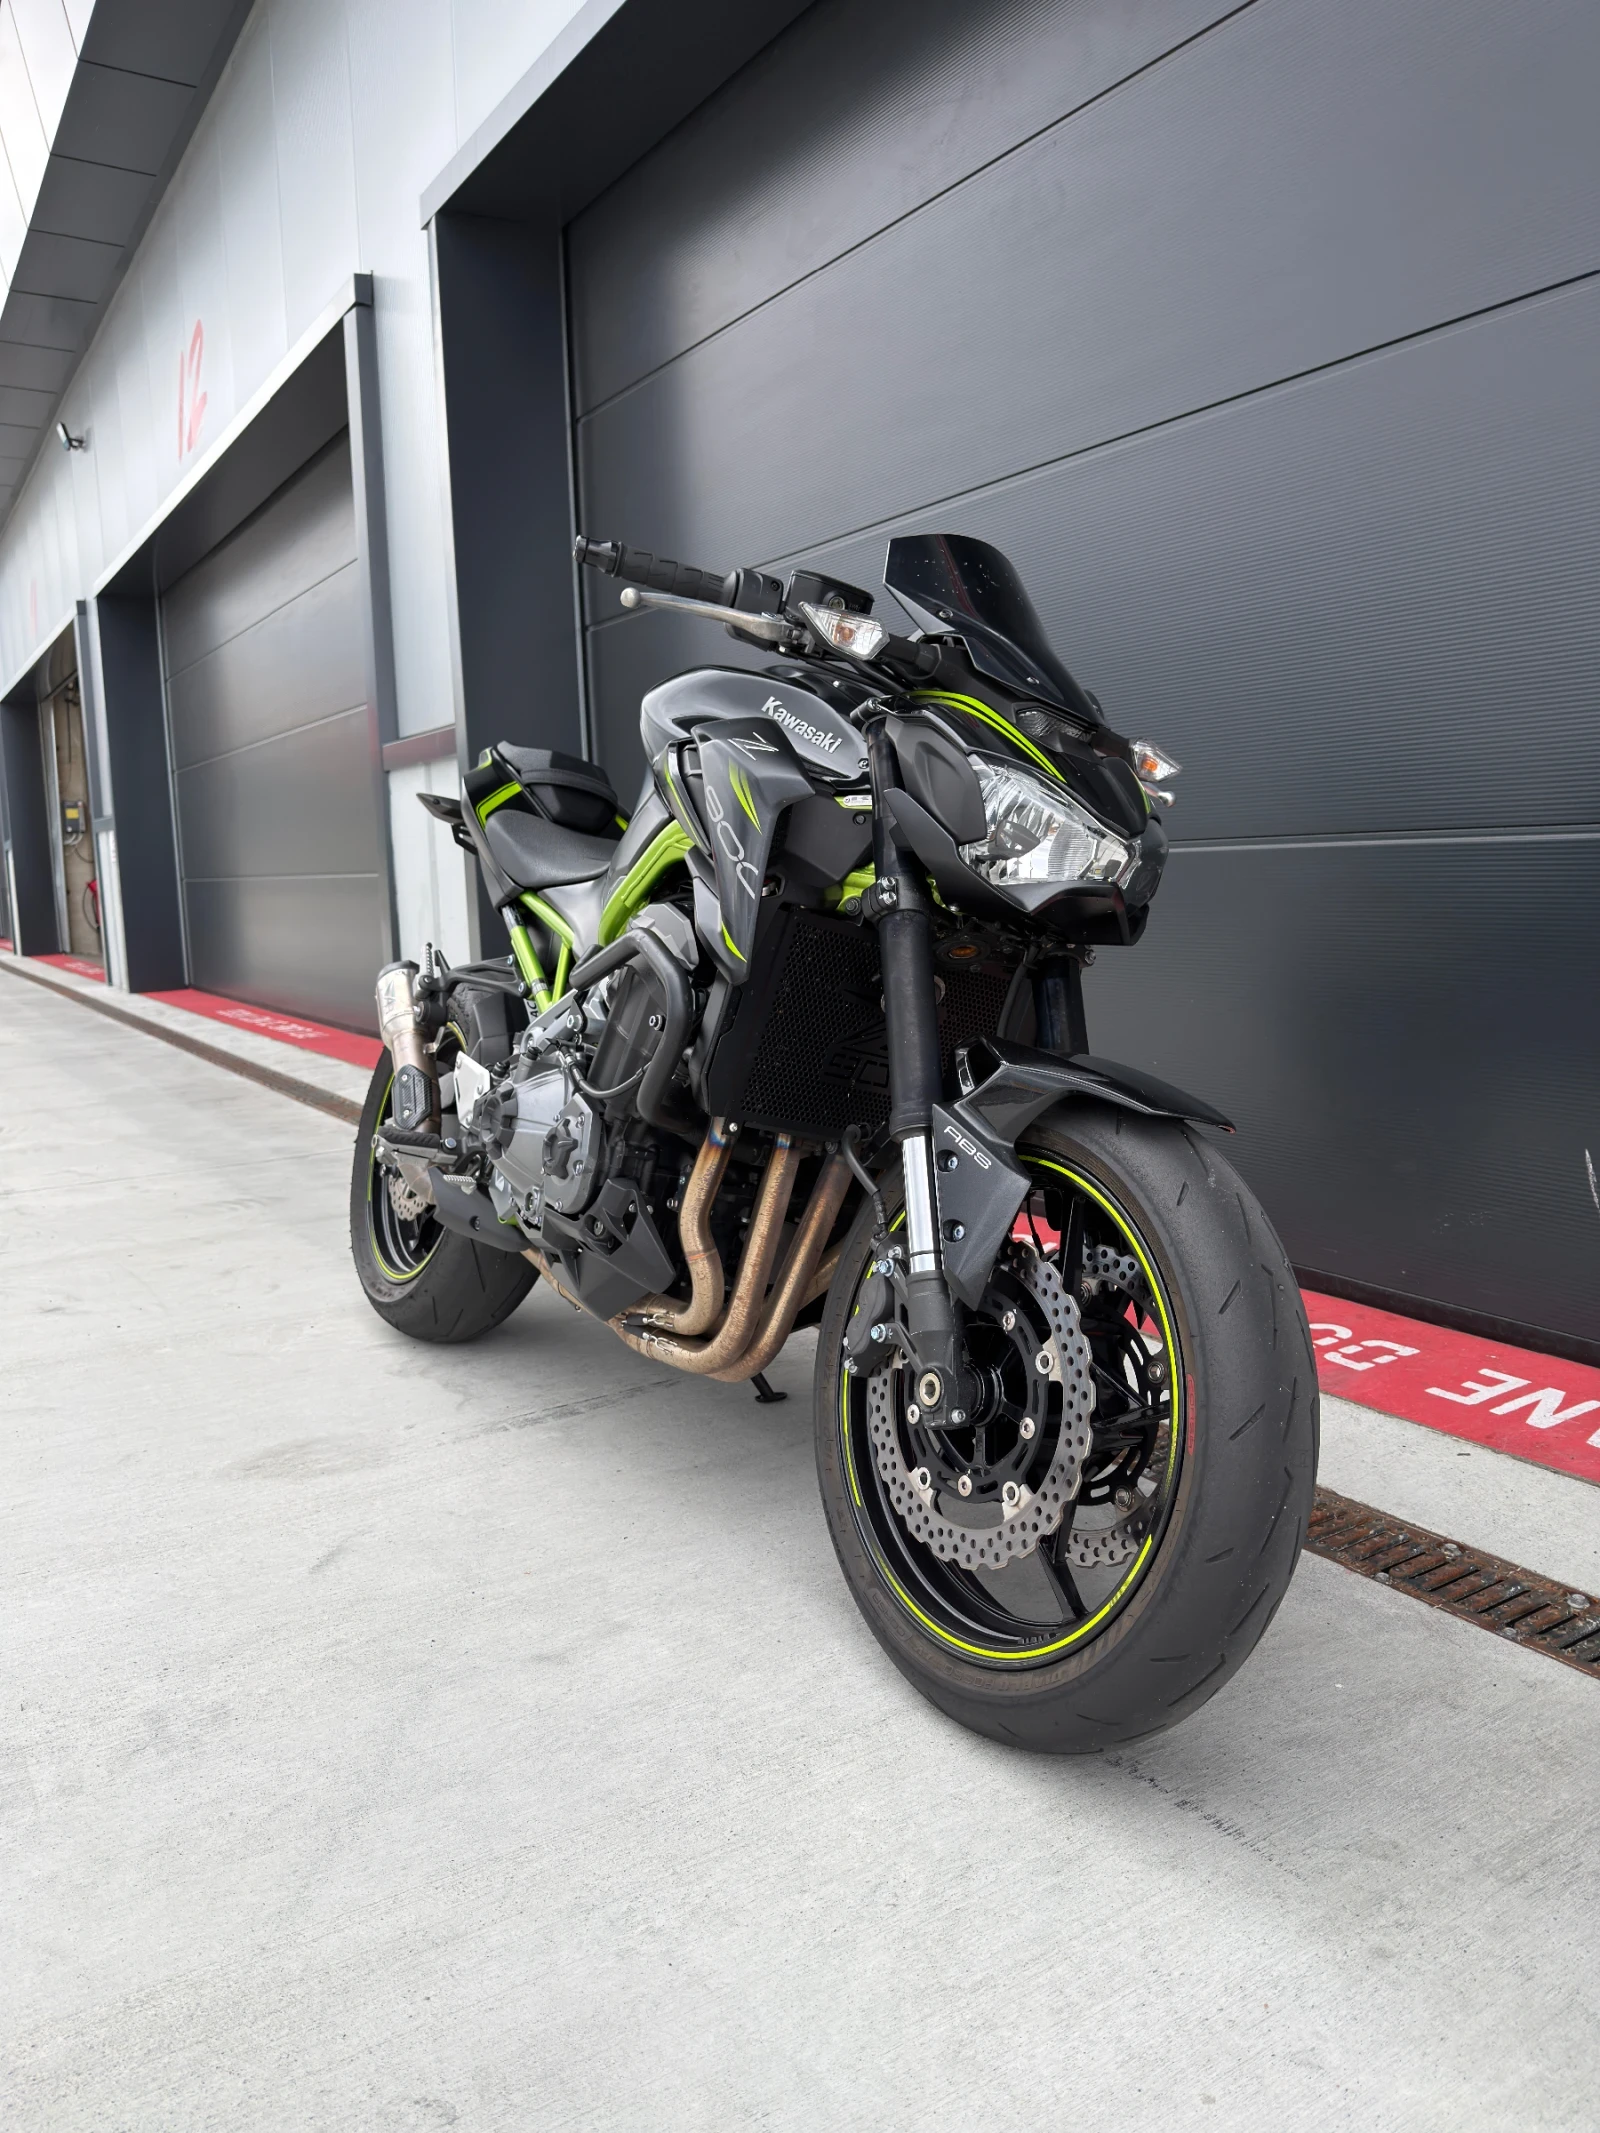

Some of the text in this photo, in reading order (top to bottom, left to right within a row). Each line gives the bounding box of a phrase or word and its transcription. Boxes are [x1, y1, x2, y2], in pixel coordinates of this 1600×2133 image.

[178, 319, 208, 464] 12
[761, 696, 842, 754] Kawasaki
[943, 1125, 992, 1170] ABS
[1424, 1368, 1600, 1449] NE
[872, 1592, 907, 1638] CORSA
[943, 1664, 996, 1690] ROSSO
